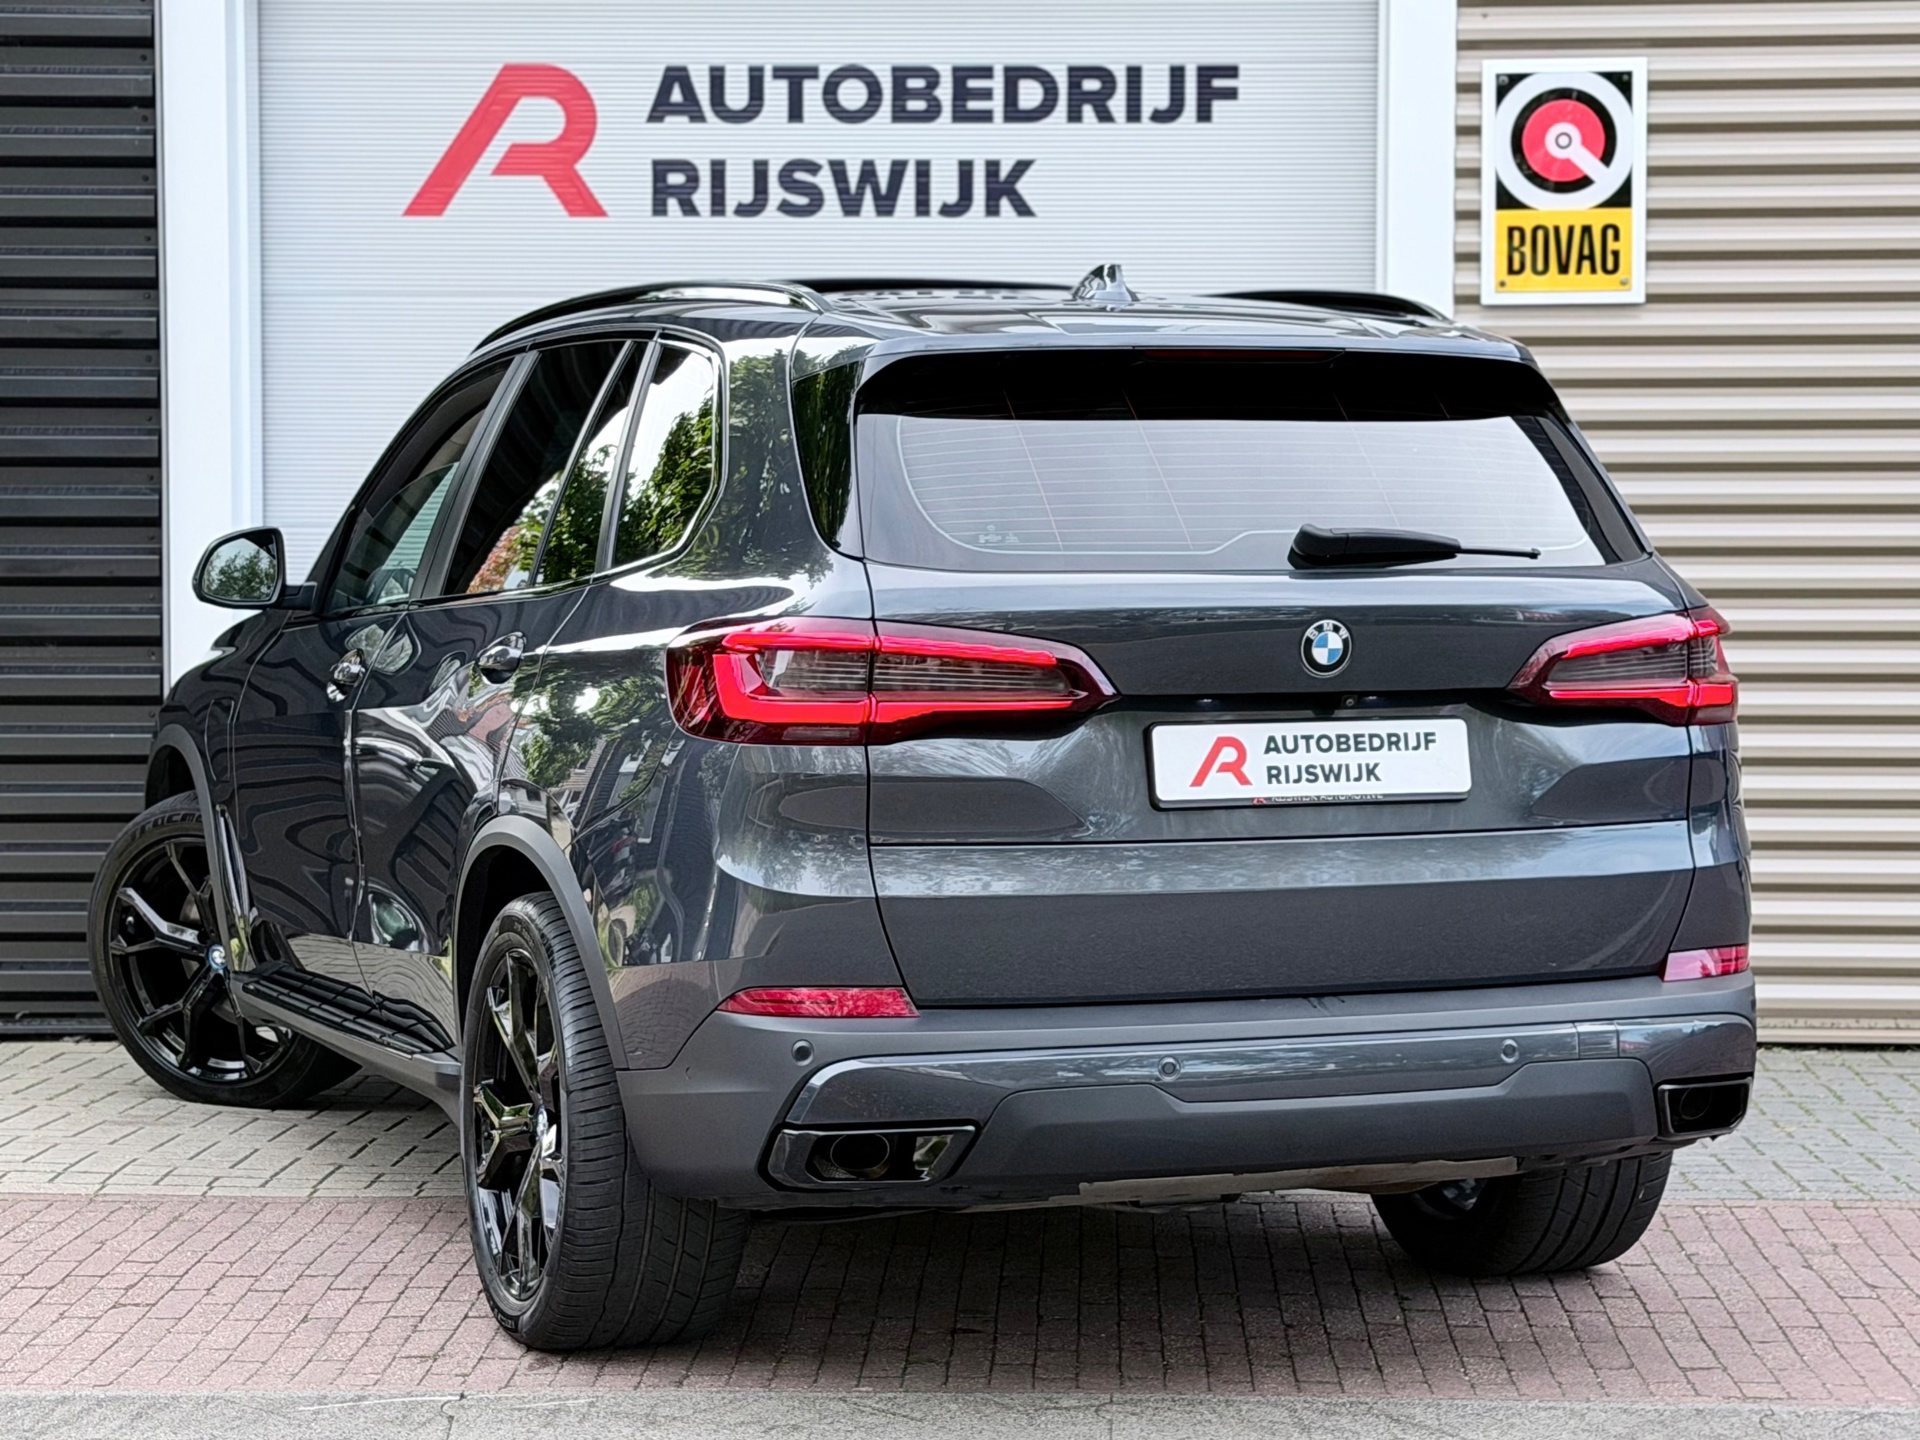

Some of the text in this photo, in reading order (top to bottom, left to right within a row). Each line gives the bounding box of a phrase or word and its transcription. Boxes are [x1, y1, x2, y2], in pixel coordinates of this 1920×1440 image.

[647, 64, 1240, 124] AUTOBEDRIJF
[652, 158, 1037, 217] RIJSWIJK
[1507, 223, 1621, 276] BOVAG
[1307, 621, 1349, 640] BMW
[1264, 731, 1437, 755] AUTOBEDRIJF
[1266, 762, 1382, 785] RIJSWIJK
